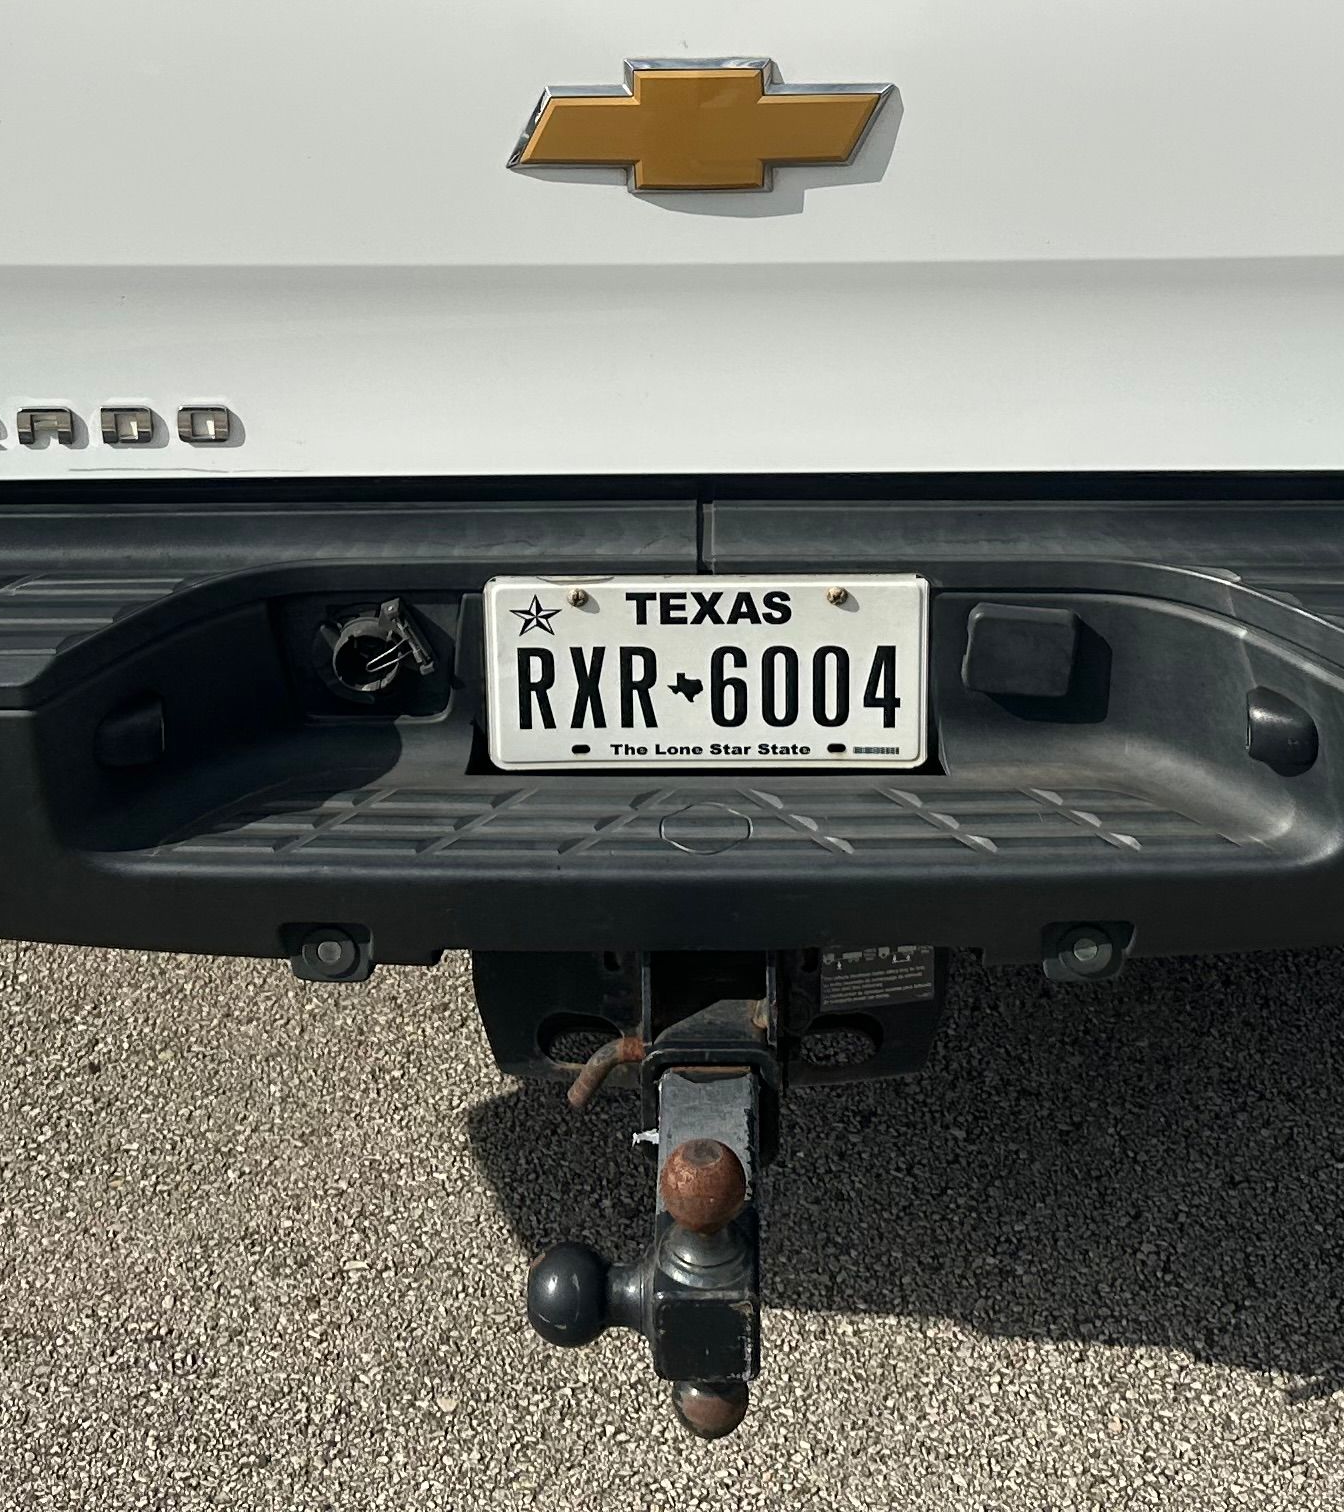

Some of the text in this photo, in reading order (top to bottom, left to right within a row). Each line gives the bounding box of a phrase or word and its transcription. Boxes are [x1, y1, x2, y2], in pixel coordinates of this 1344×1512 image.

[625, 591, 792, 626] TEXAS
[610, 743, 811, 755] The Lone Star State
